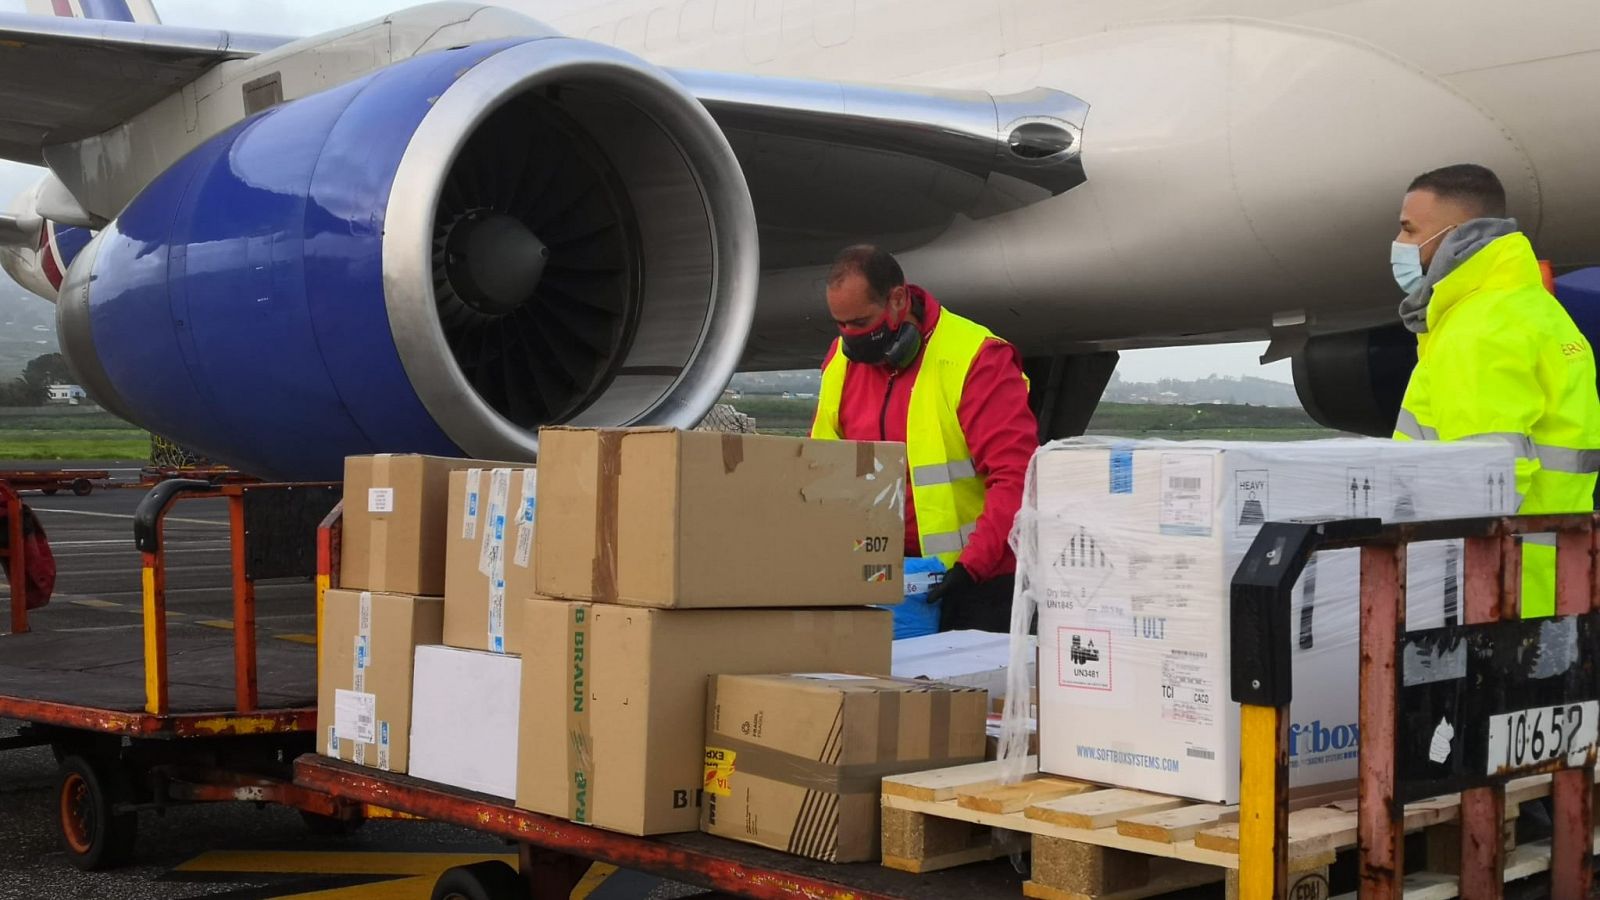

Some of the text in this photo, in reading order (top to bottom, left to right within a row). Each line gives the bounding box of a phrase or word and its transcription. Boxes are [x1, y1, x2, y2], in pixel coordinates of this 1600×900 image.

[1239, 481, 1265, 491] HEAVY
[865, 537, 889, 552] B07
[1046, 600, 1074, 610] UN1845
[1143, 617, 1166, 639] ULT
[574, 608, 585, 713] B BRAUN
[1073, 668, 1100, 678] UN3481
[1161, 685, 1174, 699] TCI
[1289, 720, 1359, 757] ftbox
[1076, 744, 1180, 773] WWW.SOFTBOXSYSTEMS.COM
